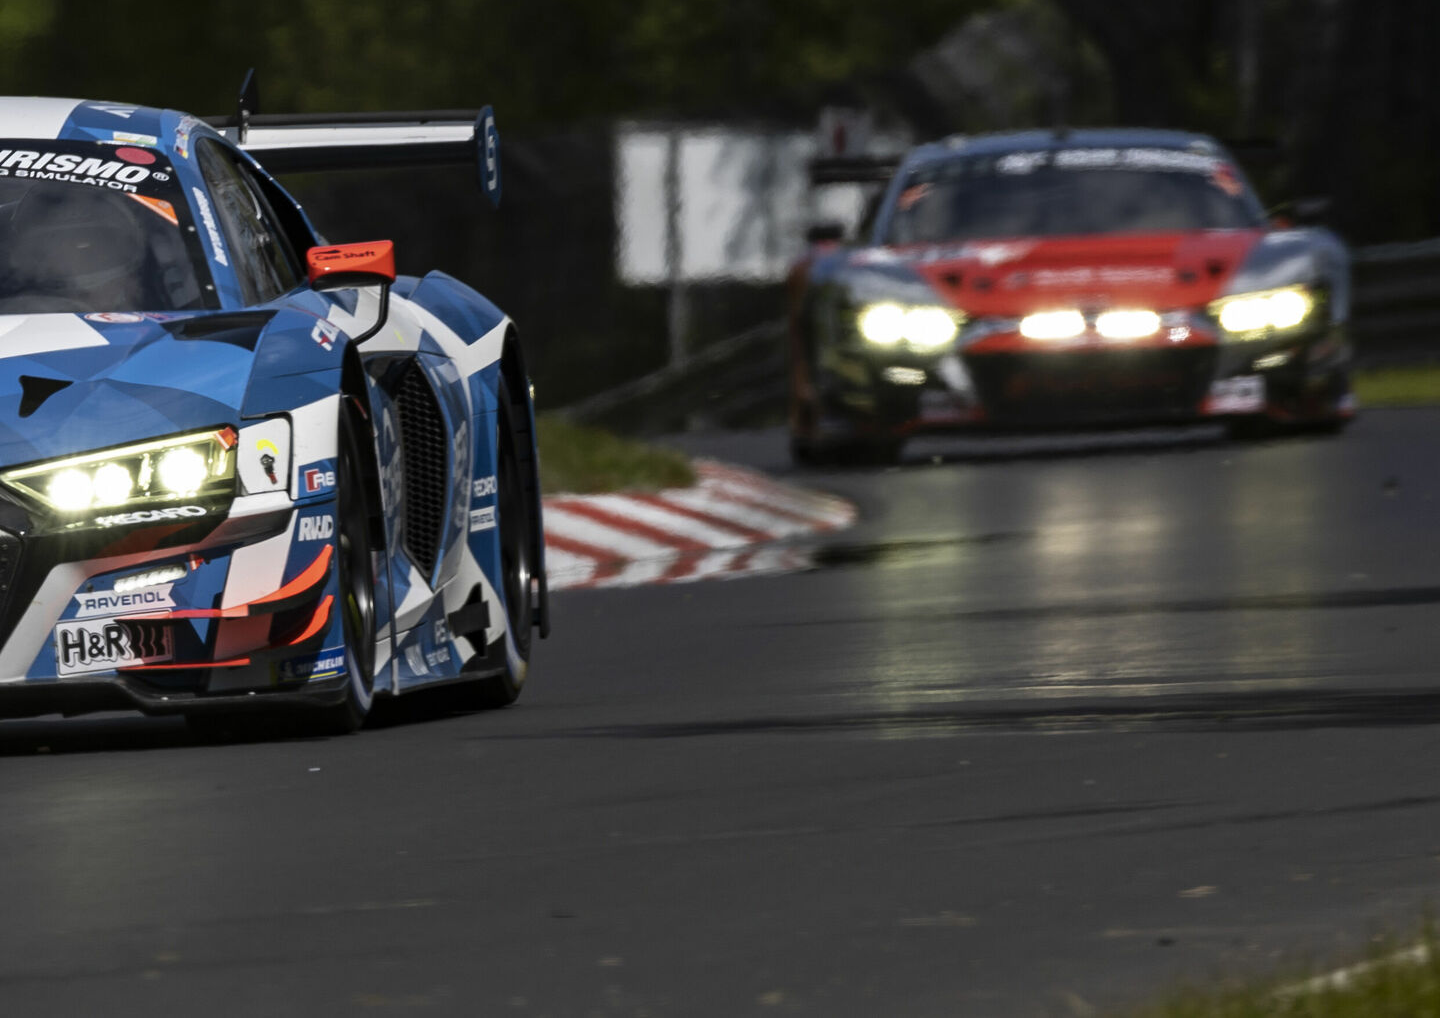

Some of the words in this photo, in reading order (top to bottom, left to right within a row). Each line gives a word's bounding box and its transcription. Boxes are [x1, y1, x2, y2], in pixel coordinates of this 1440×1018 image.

[15, 169, 138, 193] SIMULATOR
[85, 591, 166, 610] RAVENOL
[62, 624, 132, 667] H&R
